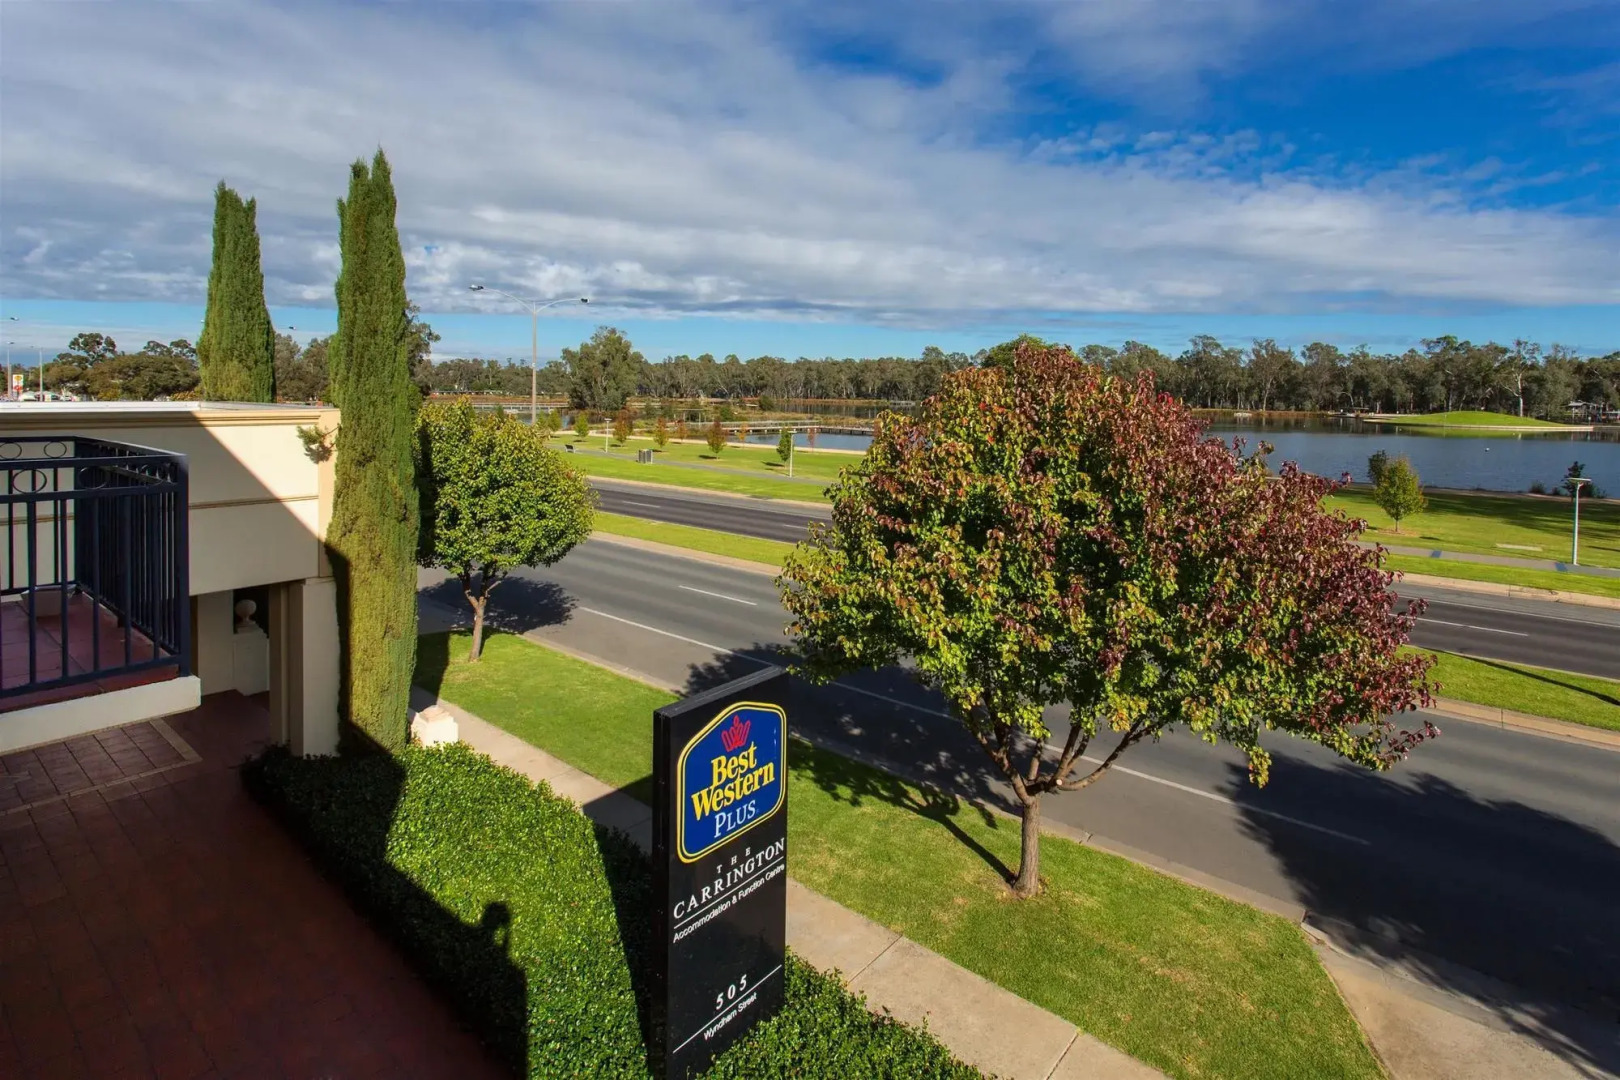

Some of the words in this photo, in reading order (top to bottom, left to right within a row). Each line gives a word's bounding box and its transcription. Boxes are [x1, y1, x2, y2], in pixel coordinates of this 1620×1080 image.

[711, 741, 757, 787] Best
[691, 762, 775, 821] Western
[714, 800, 756, 838] PLUS
[673, 838, 785, 919] CARRINGTON
[716, 847, 751, 873] THE
[673, 902, 730, 943] Accommodation
[732, 895, 738, 905] &
[738, 876, 765, 900] Function
[765, 864, 785, 881] Centre
[715, 974, 747, 1010] 505
[703, 1010, 738, 1040] Wyndham
[737, 992, 758, 1012] Street
